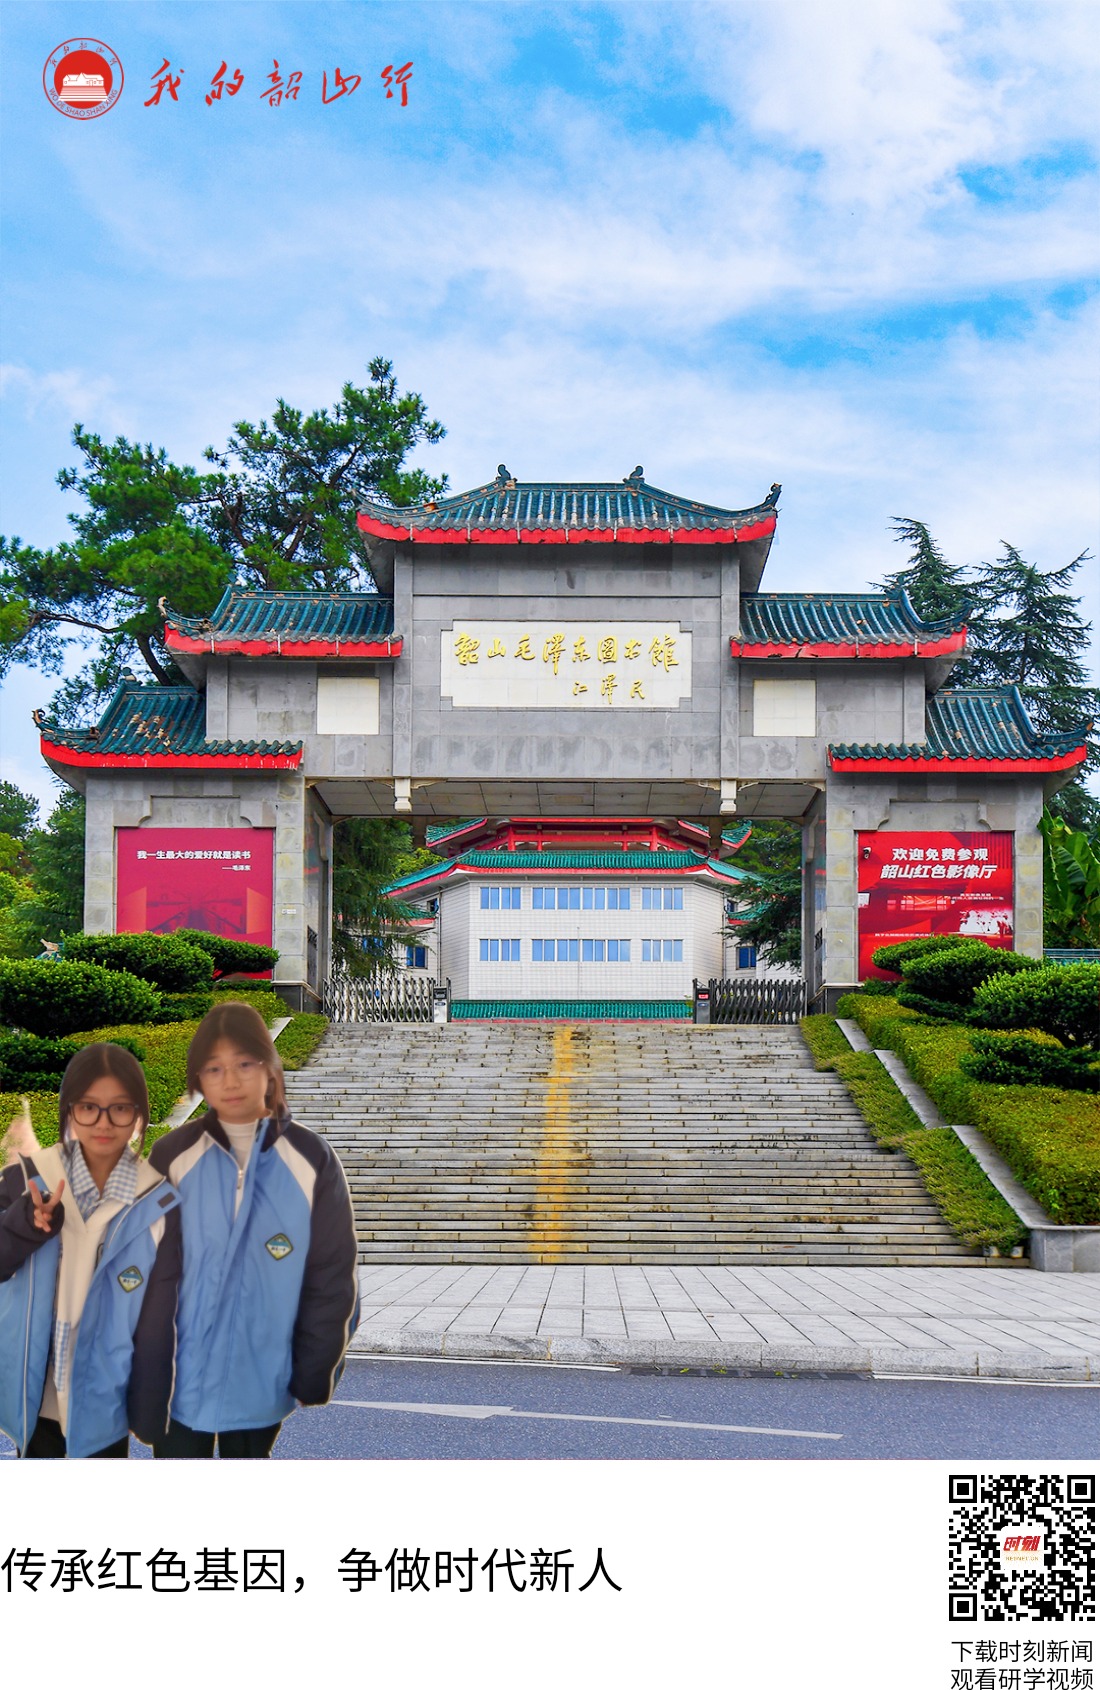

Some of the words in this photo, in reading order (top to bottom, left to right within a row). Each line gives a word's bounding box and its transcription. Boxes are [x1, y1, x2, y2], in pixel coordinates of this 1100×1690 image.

[137, 850, 251, 859] 我一生最大的爱好就是读书
[892, 848, 988, 861] 欢迎免费参观
[880, 864, 997, 879] 韶山红色影像厅
